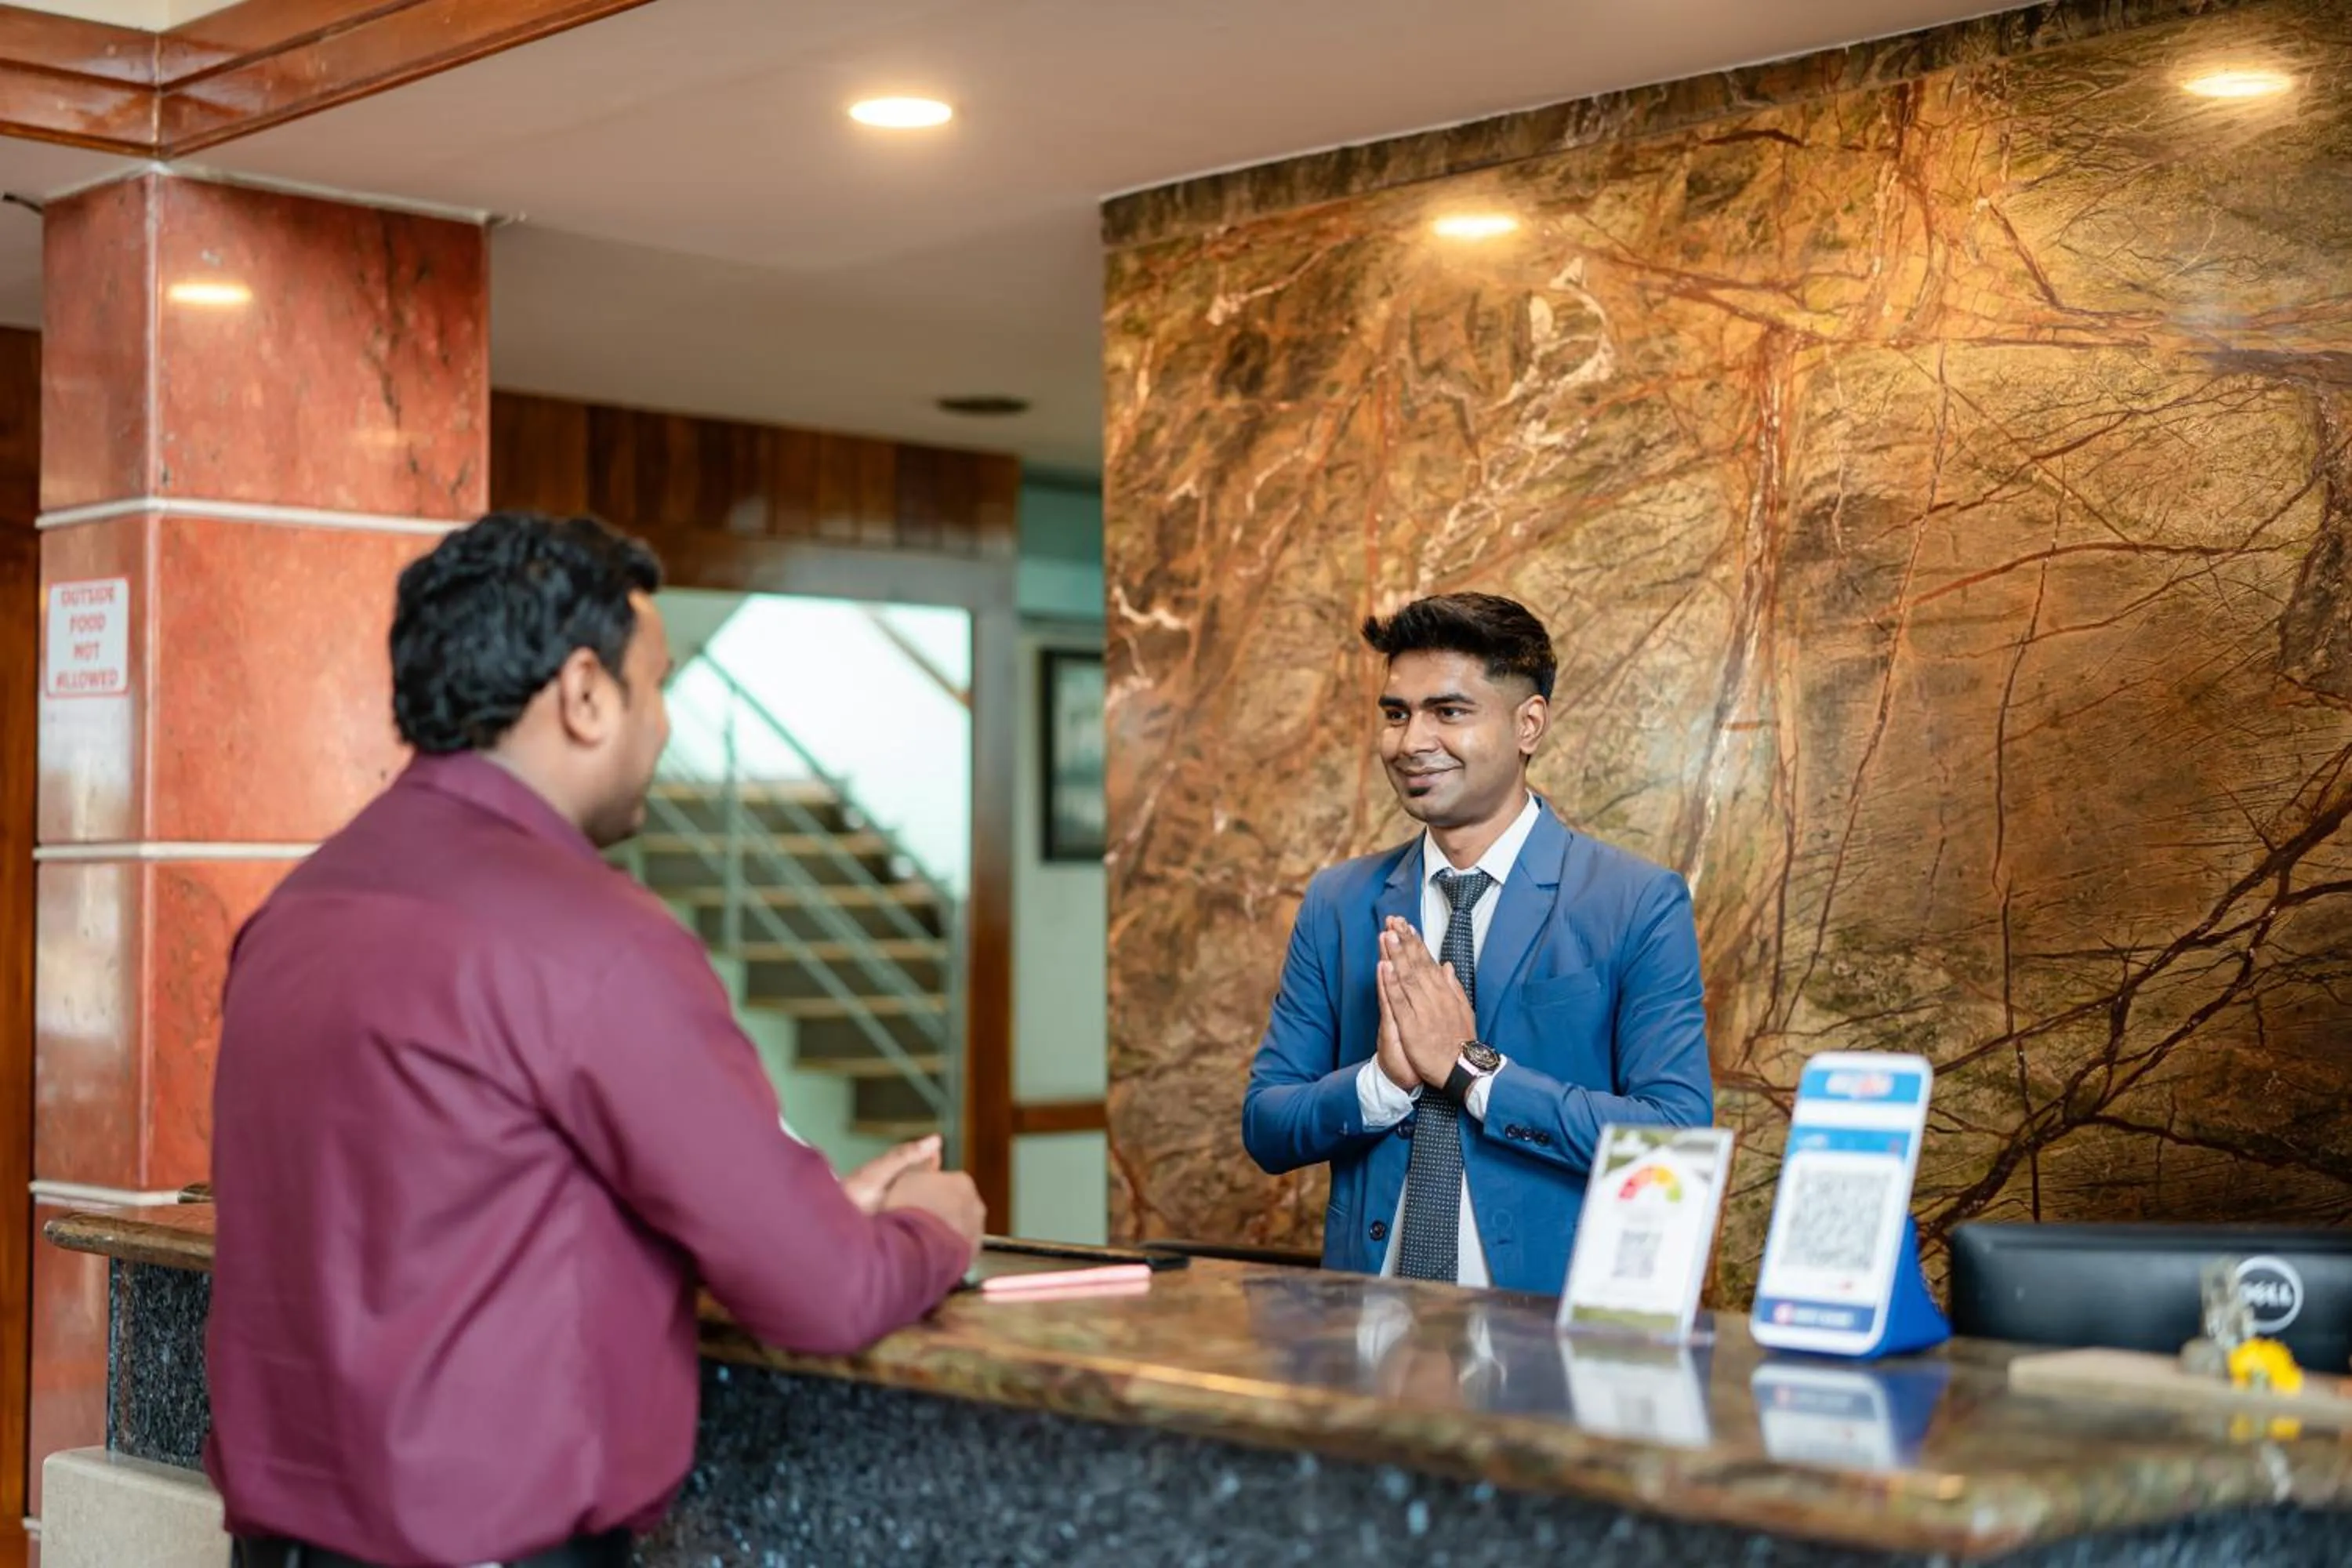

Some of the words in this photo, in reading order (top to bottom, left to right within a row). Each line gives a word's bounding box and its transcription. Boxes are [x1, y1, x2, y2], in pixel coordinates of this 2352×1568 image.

[60, 587, 114, 606] OUTSIDE
[70, 613, 106, 632] FOOD
[74, 641, 100, 660] NOT
[56, 669, 118, 688] ALLOWED
